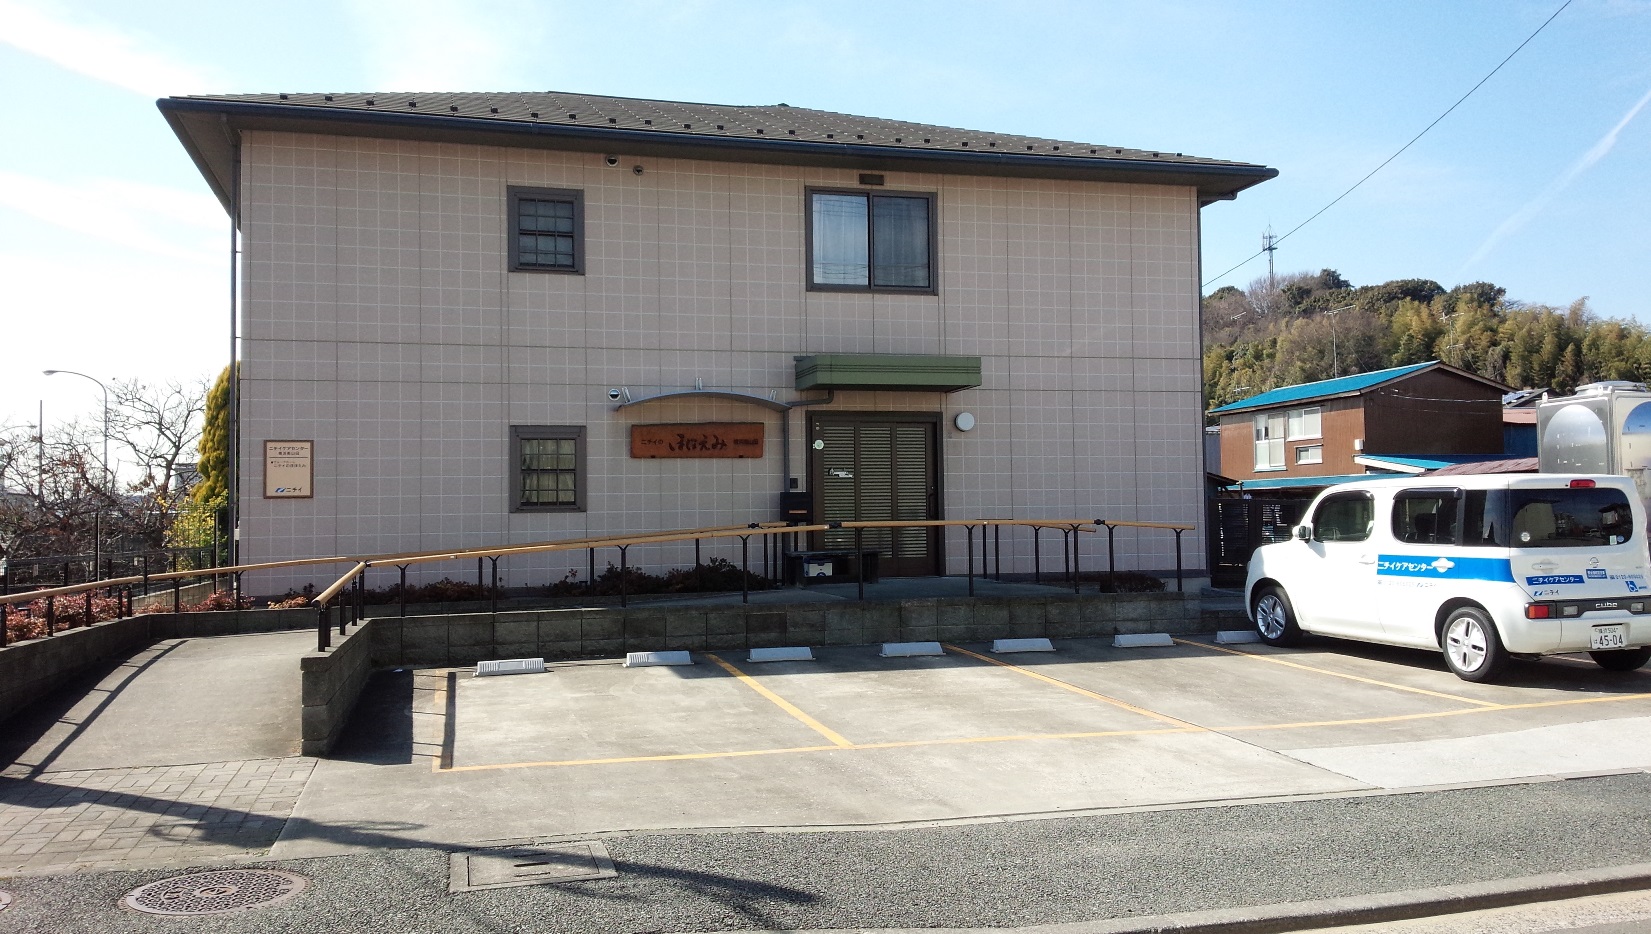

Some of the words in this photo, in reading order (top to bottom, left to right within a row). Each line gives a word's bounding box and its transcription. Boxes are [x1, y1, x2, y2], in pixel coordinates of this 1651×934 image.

[1378, 562, 1433, 572] ニチイケアセンター
[1531, 576, 1580, 584] ニチイケアセンター
[1599, 633, 1624, 647] 45-04
